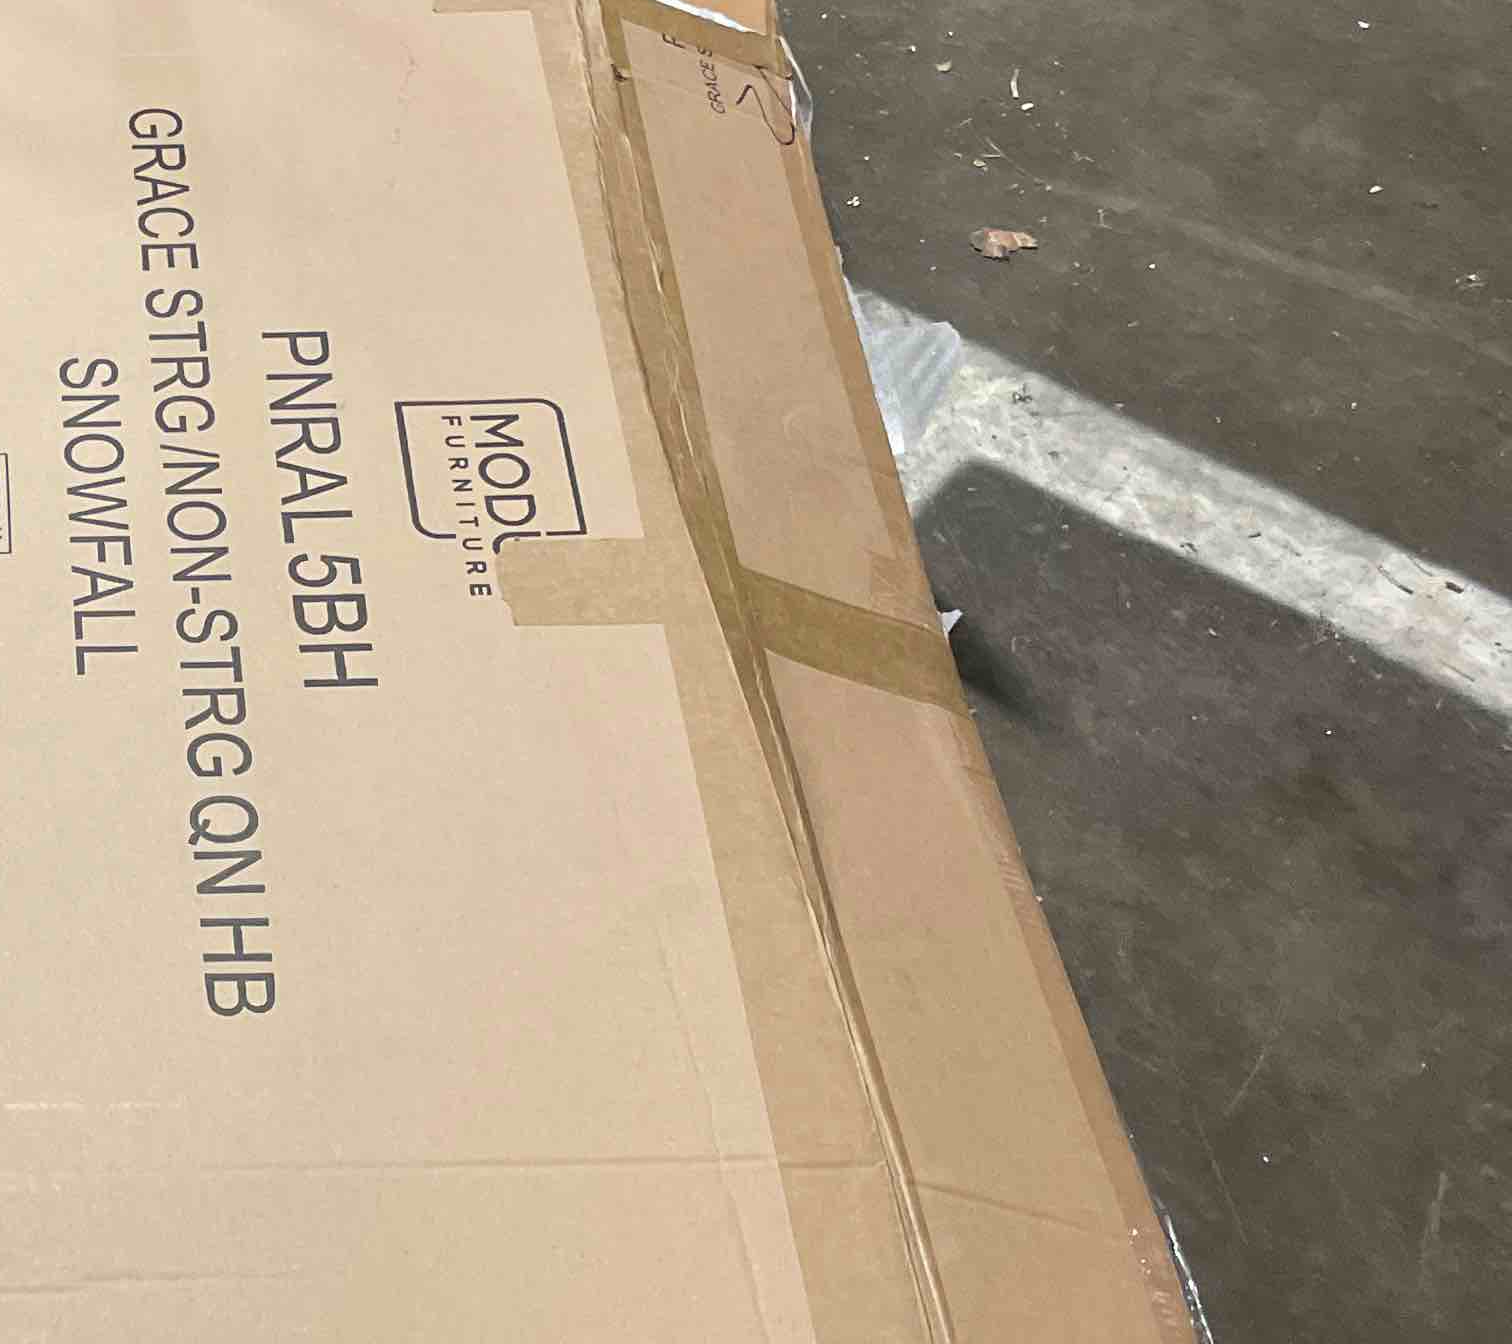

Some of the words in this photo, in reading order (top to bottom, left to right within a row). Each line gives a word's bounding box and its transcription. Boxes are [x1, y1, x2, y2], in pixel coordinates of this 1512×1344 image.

[699, 59, 726, 114] GRACE
[129, 109, 199, 271] GRACE
[262, 331, 353, 544] PNRAL
[441, 416, 492, 596] FURNITURE
[59, 358, 138, 675] SNOWFALL
[288, 553, 378, 688] 5BH
[188, 796, 265, 894] QN
[200, 917, 275, 1016] HB
